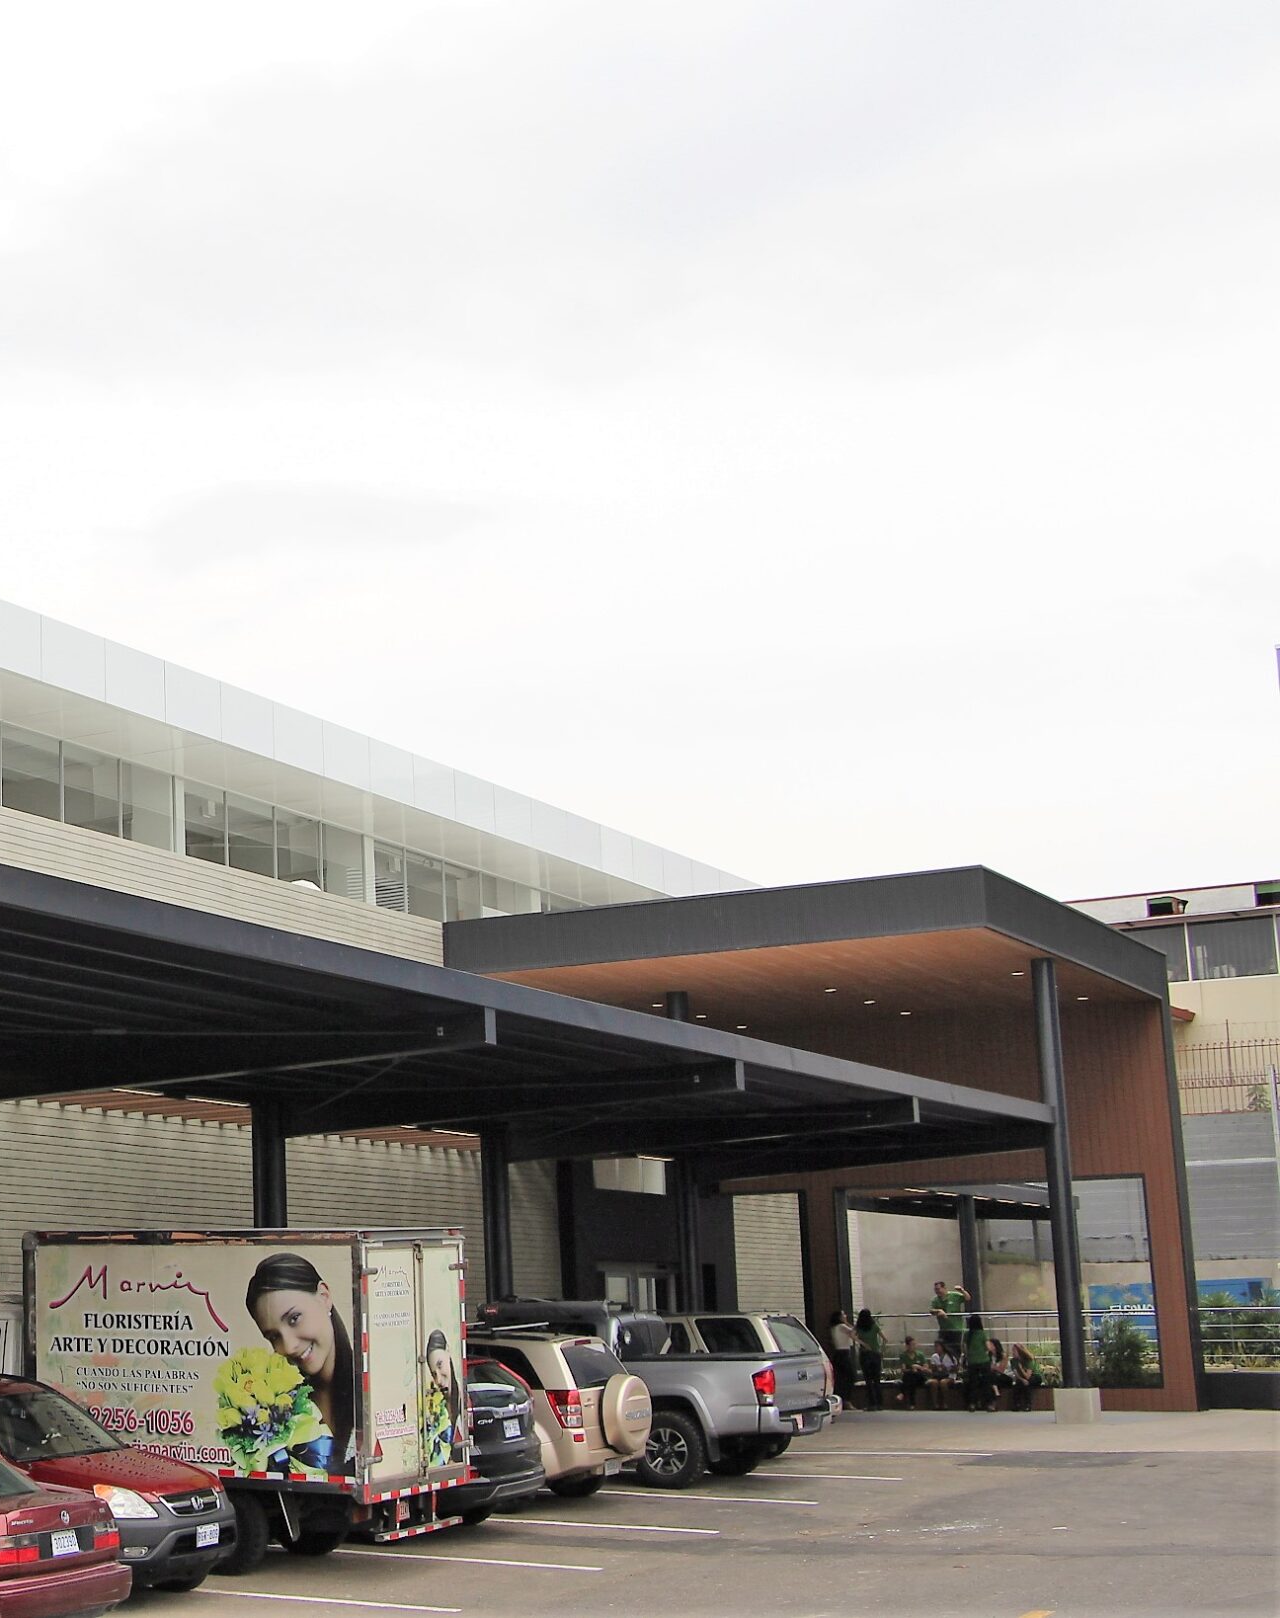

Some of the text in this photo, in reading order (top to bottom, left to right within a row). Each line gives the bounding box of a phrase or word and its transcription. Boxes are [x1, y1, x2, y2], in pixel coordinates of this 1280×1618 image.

[49, 1264, 229, 1333] Marvin
[83, 1310, 194, 1331] FLORISTERÍA
[49, 1336, 230, 1358] ARTE Y DECORACIÓN
[76, 1366, 200, 1381] CUANDO LAS PALABRAS
[98, 1382, 118, 1391] SON
